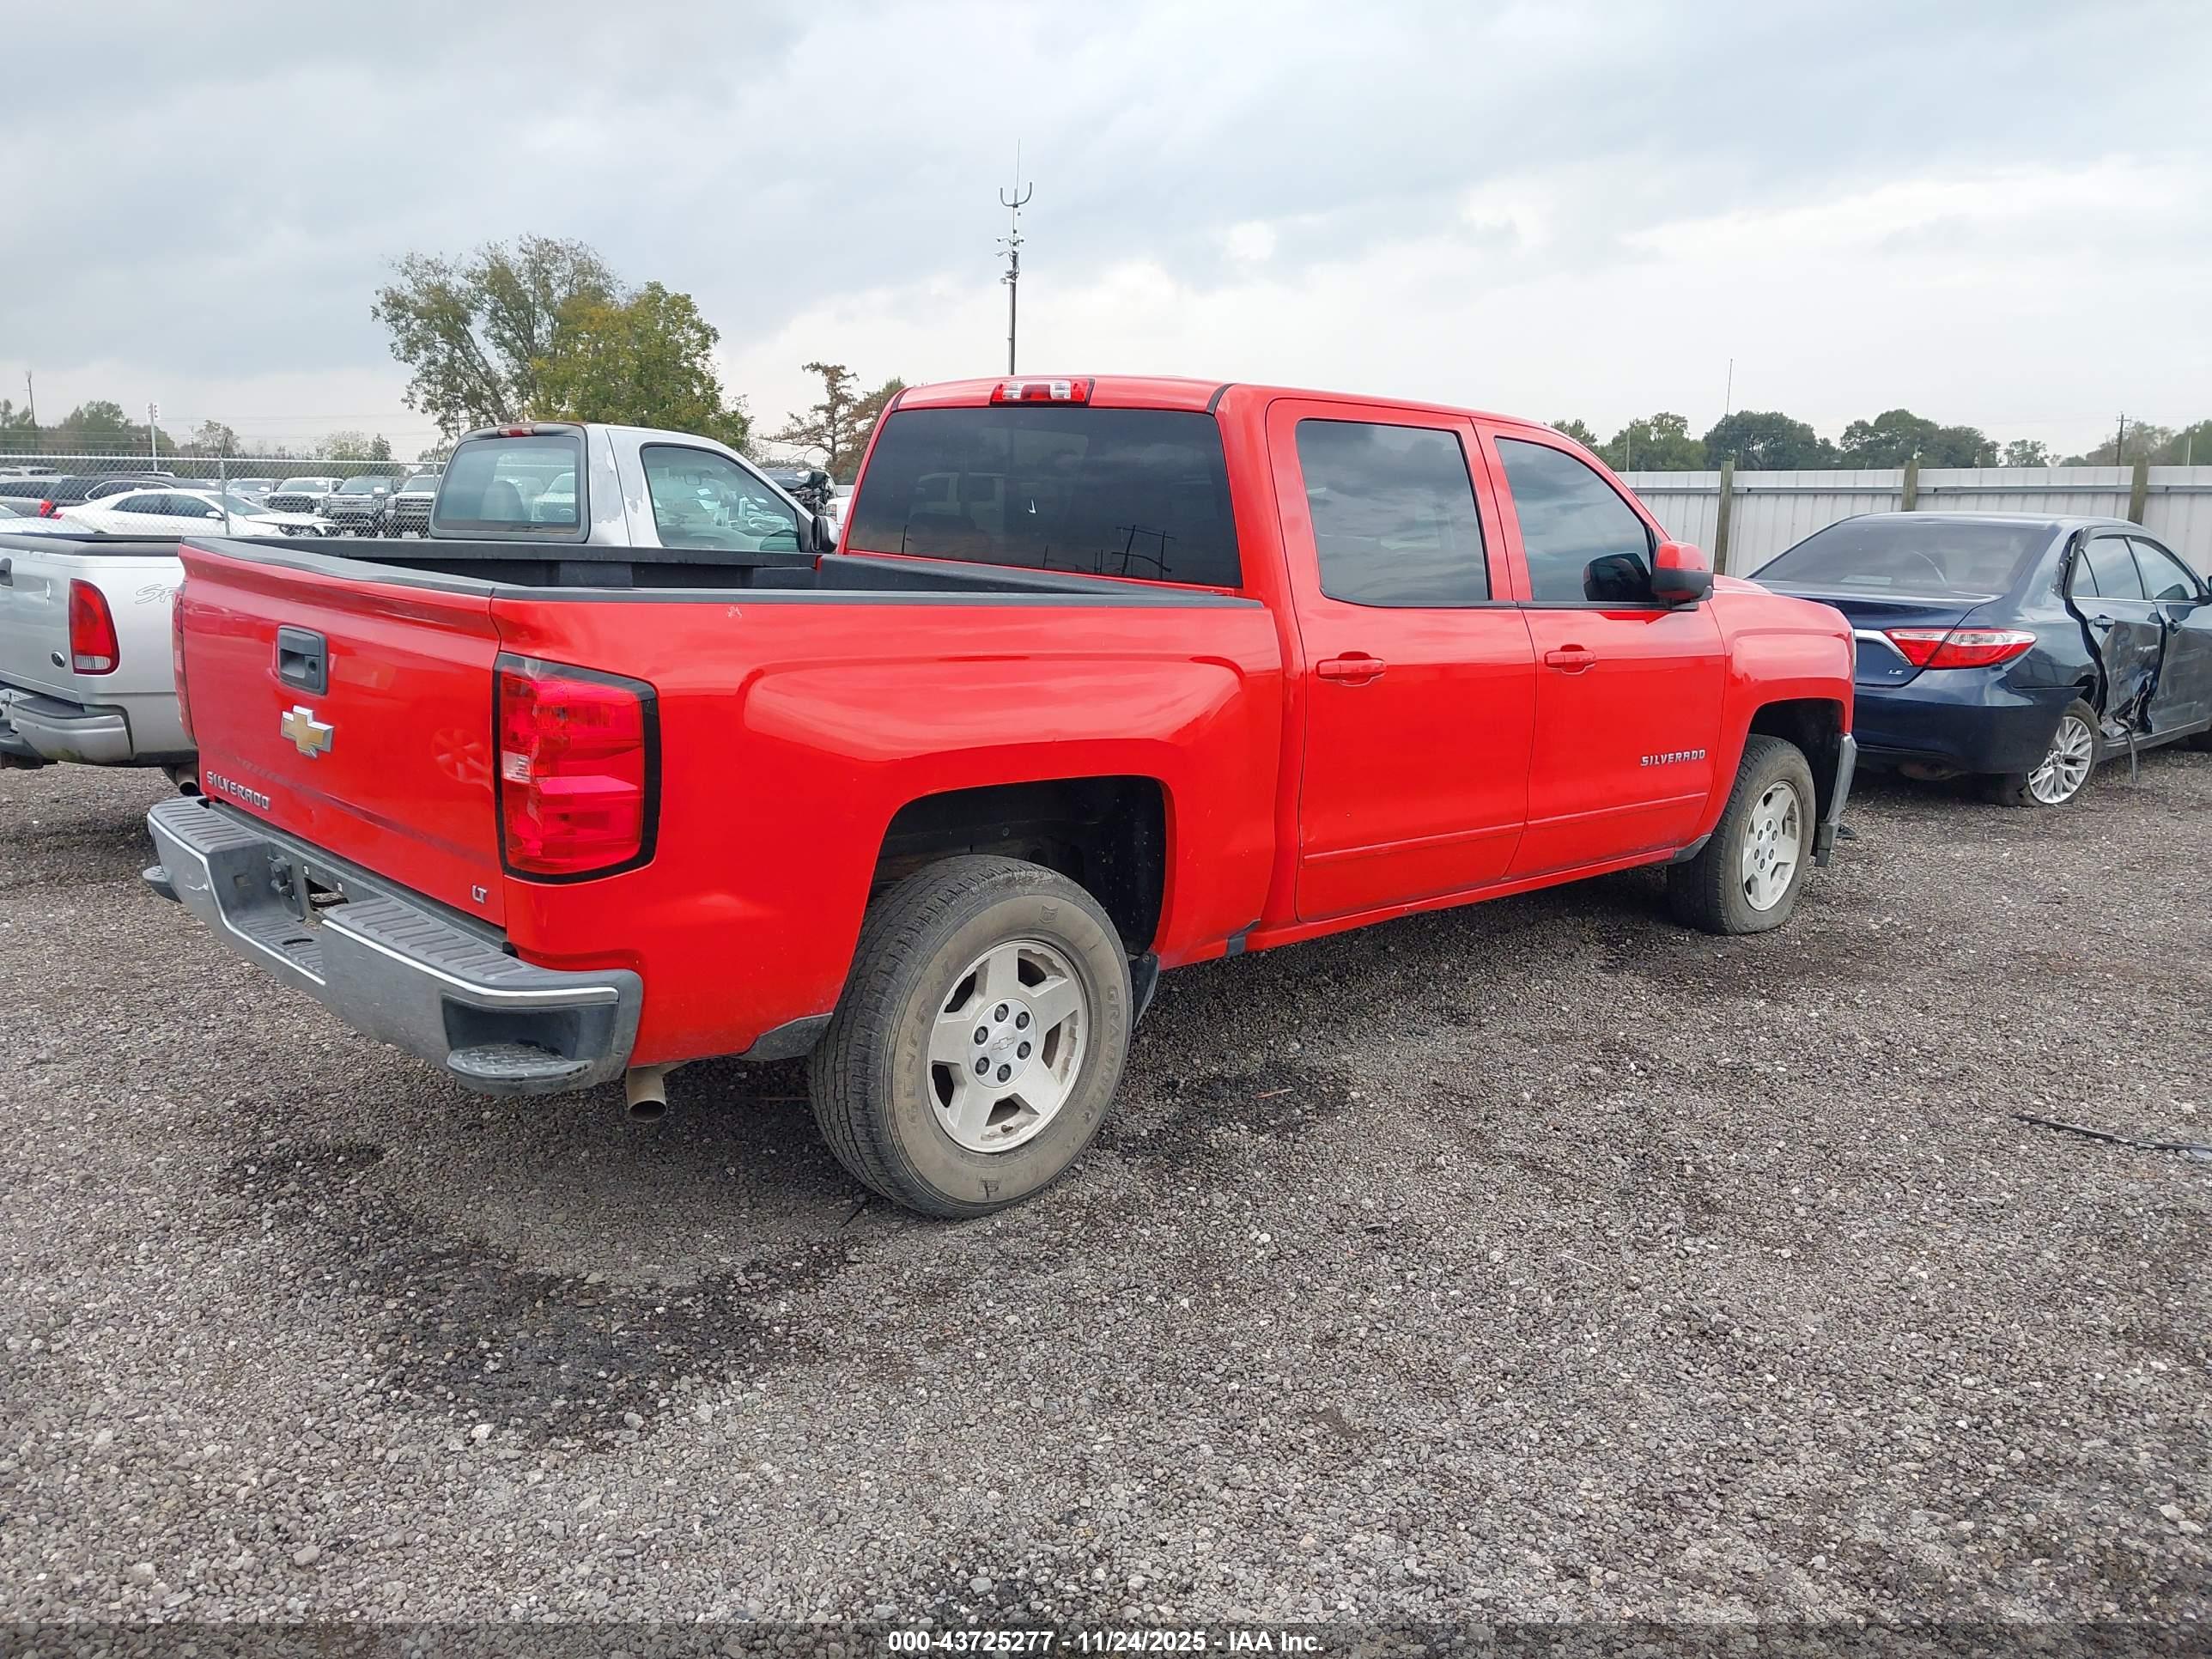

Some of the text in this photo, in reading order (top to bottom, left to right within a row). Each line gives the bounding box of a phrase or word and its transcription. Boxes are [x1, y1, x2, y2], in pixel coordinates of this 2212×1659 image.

[1640, 749, 1706, 767] SILVERADO
[206, 770, 271, 811] SILVERADO
[471, 884, 488, 904] LT
